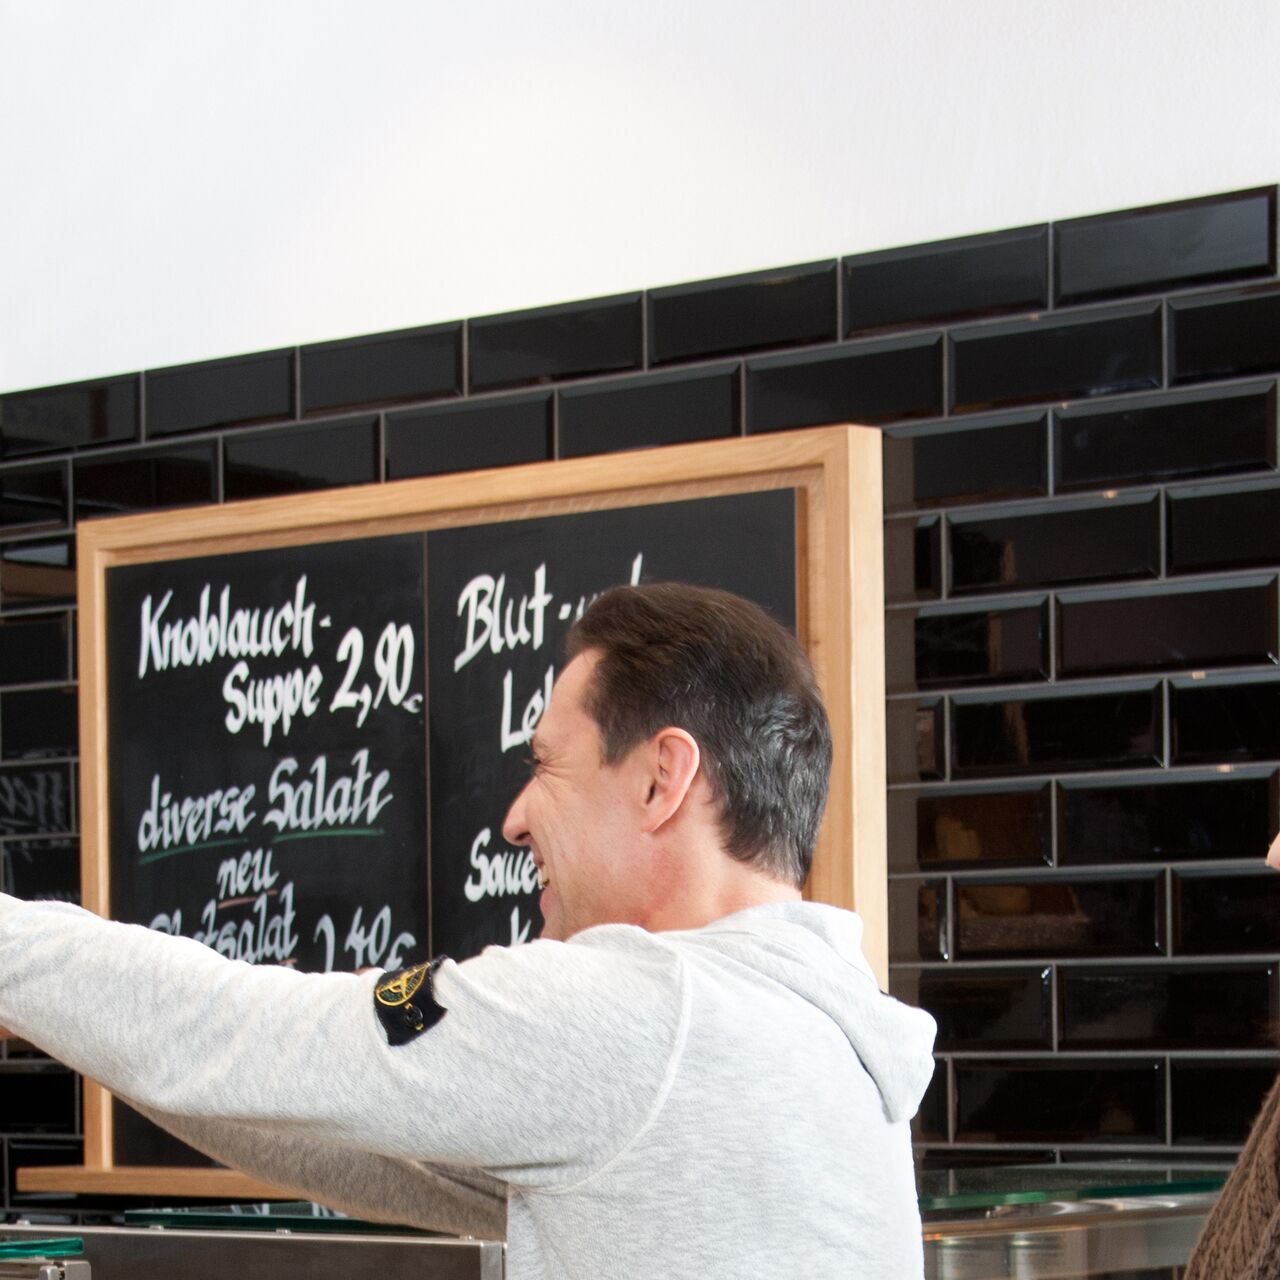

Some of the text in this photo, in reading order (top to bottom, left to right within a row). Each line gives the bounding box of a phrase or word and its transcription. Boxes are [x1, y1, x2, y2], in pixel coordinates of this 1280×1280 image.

[139, 574, 332, 680] Knoblauch-
[222, 660, 324, 747] Suppe
[137, 773, 257, 853] diverse
[262, 749, 394, 834] Salate
[216, 848, 279, 899] neu
[464, 826, 538, 903] Saue
